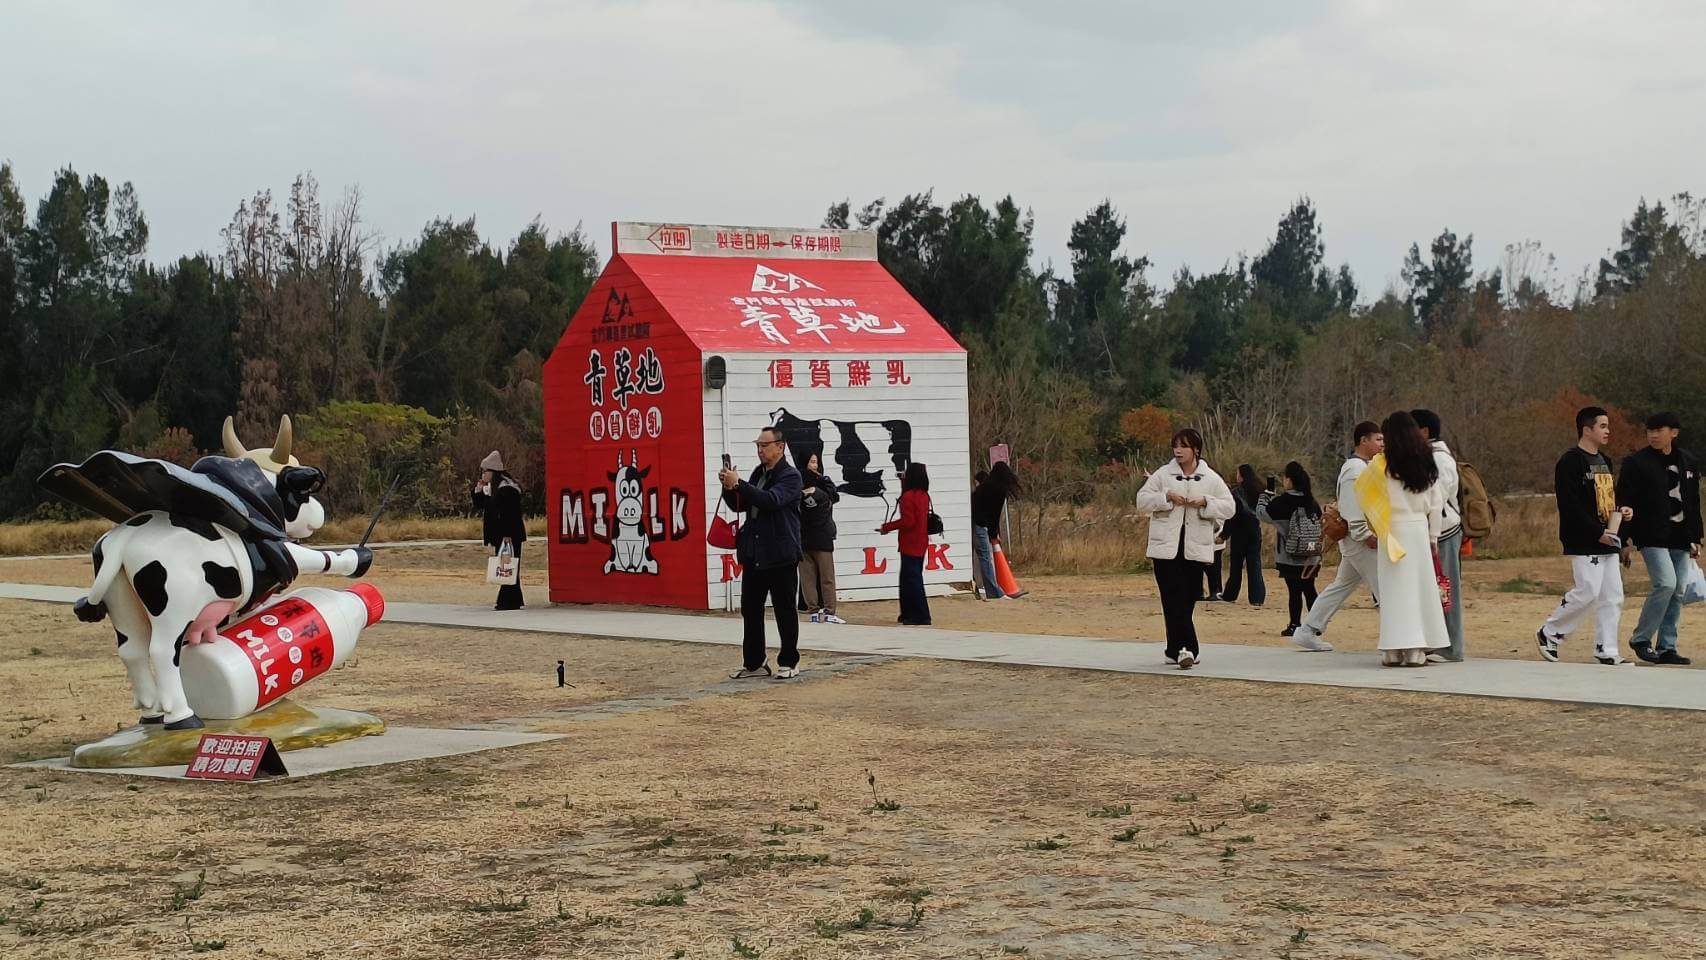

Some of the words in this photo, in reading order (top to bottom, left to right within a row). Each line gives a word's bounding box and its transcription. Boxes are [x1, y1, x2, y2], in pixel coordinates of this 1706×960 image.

[717, 231, 770, 250] 製造日期
[791, 234, 842, 252] 保存期限
[740, 304, 906, 345] 青草地
[584, 346, 665, 410] 青草地
[767, 359, 911, 388] 優質鮮乳
[560, 486, 689, 543] MILK
[236, 629, 279, 695] MILK
[201, 738, 262, 756] 歡迎拍照
